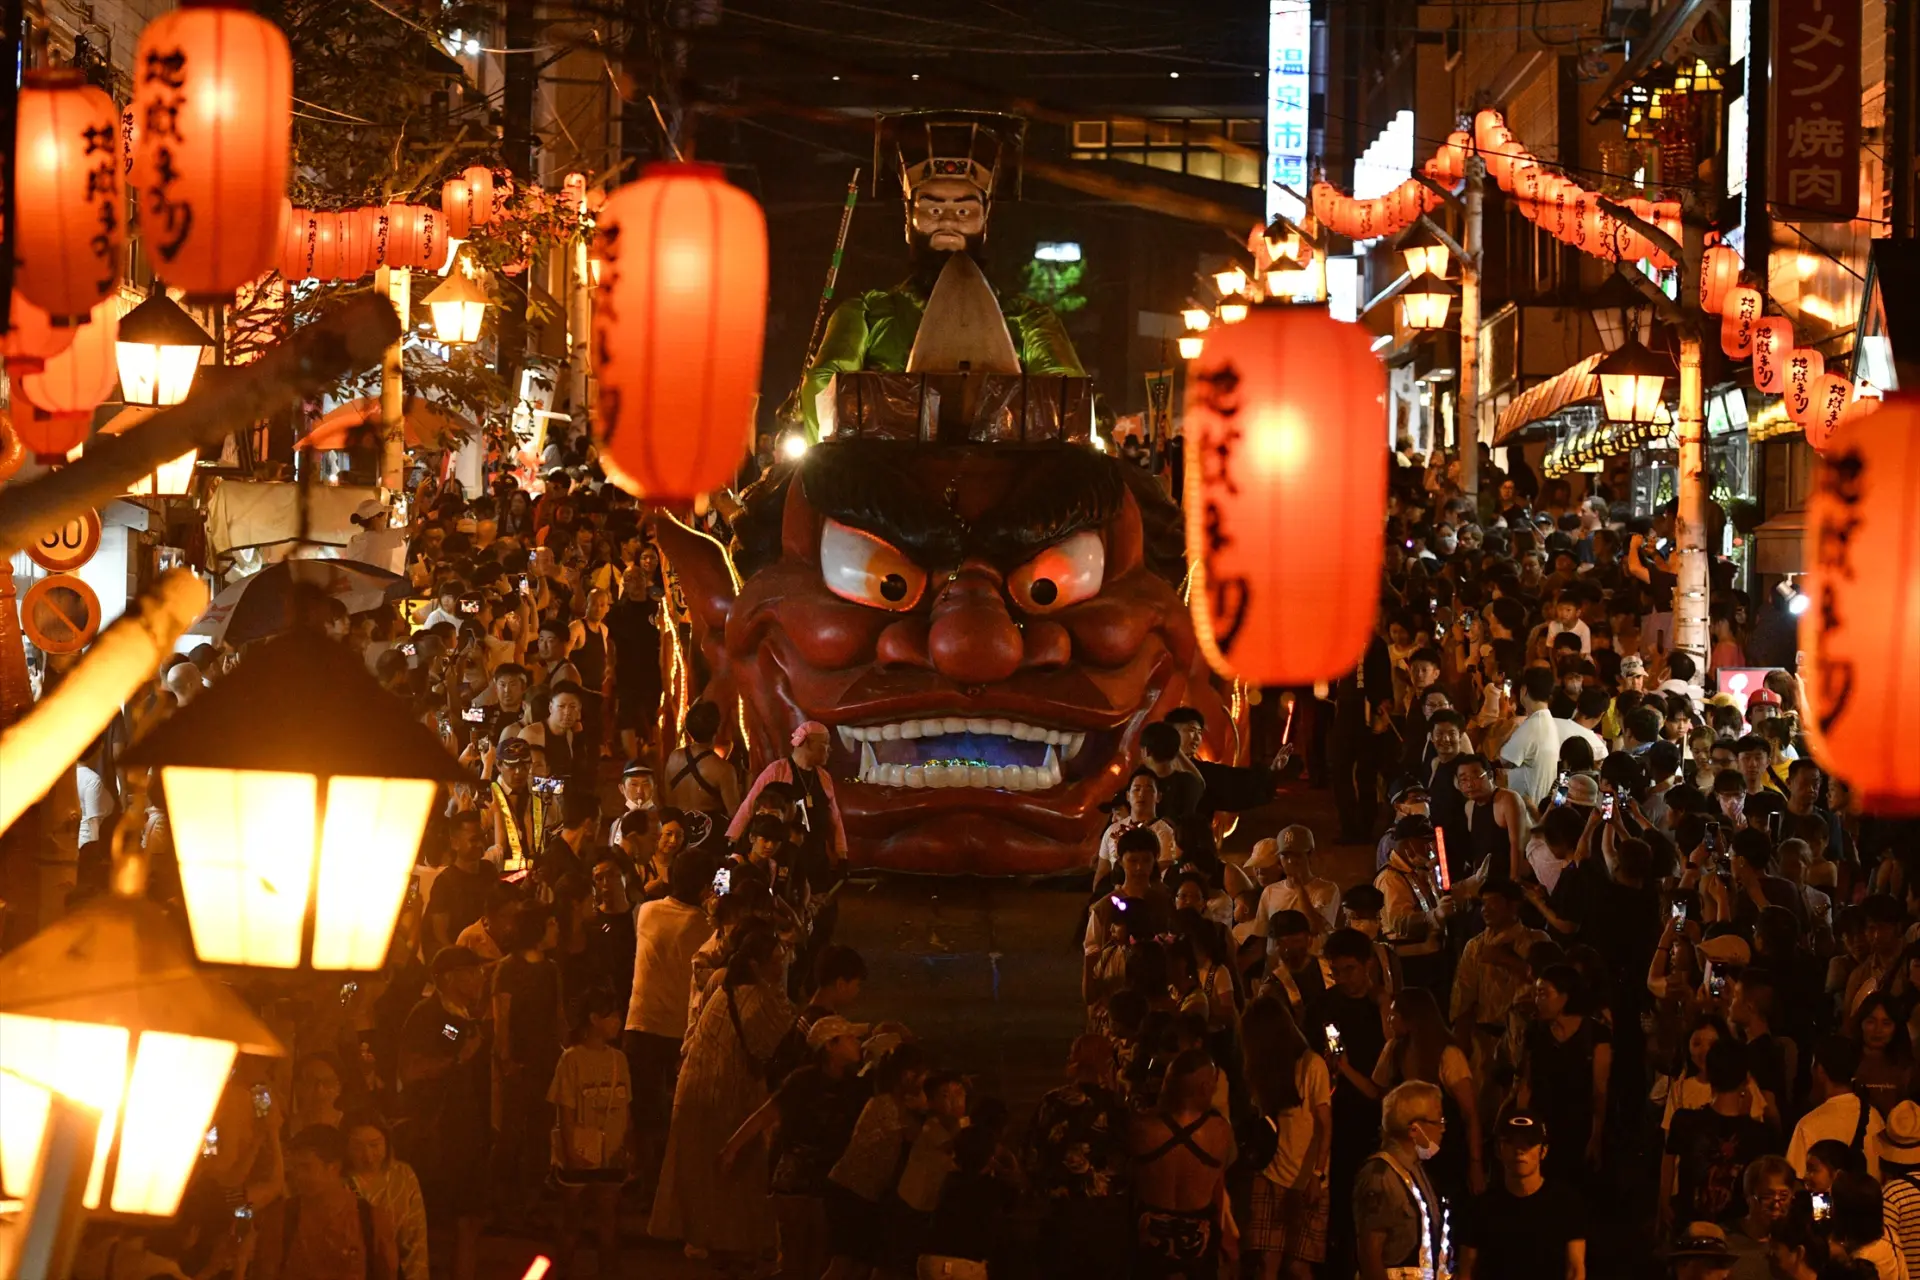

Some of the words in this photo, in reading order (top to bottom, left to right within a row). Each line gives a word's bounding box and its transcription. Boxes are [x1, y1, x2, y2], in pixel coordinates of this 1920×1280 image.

[1273, 48, 1304, 187] 温泉市場
[1756, 326, 1774, 388] 地獄まつり
[1791, 357, 1809, 415] 地獄まつり
